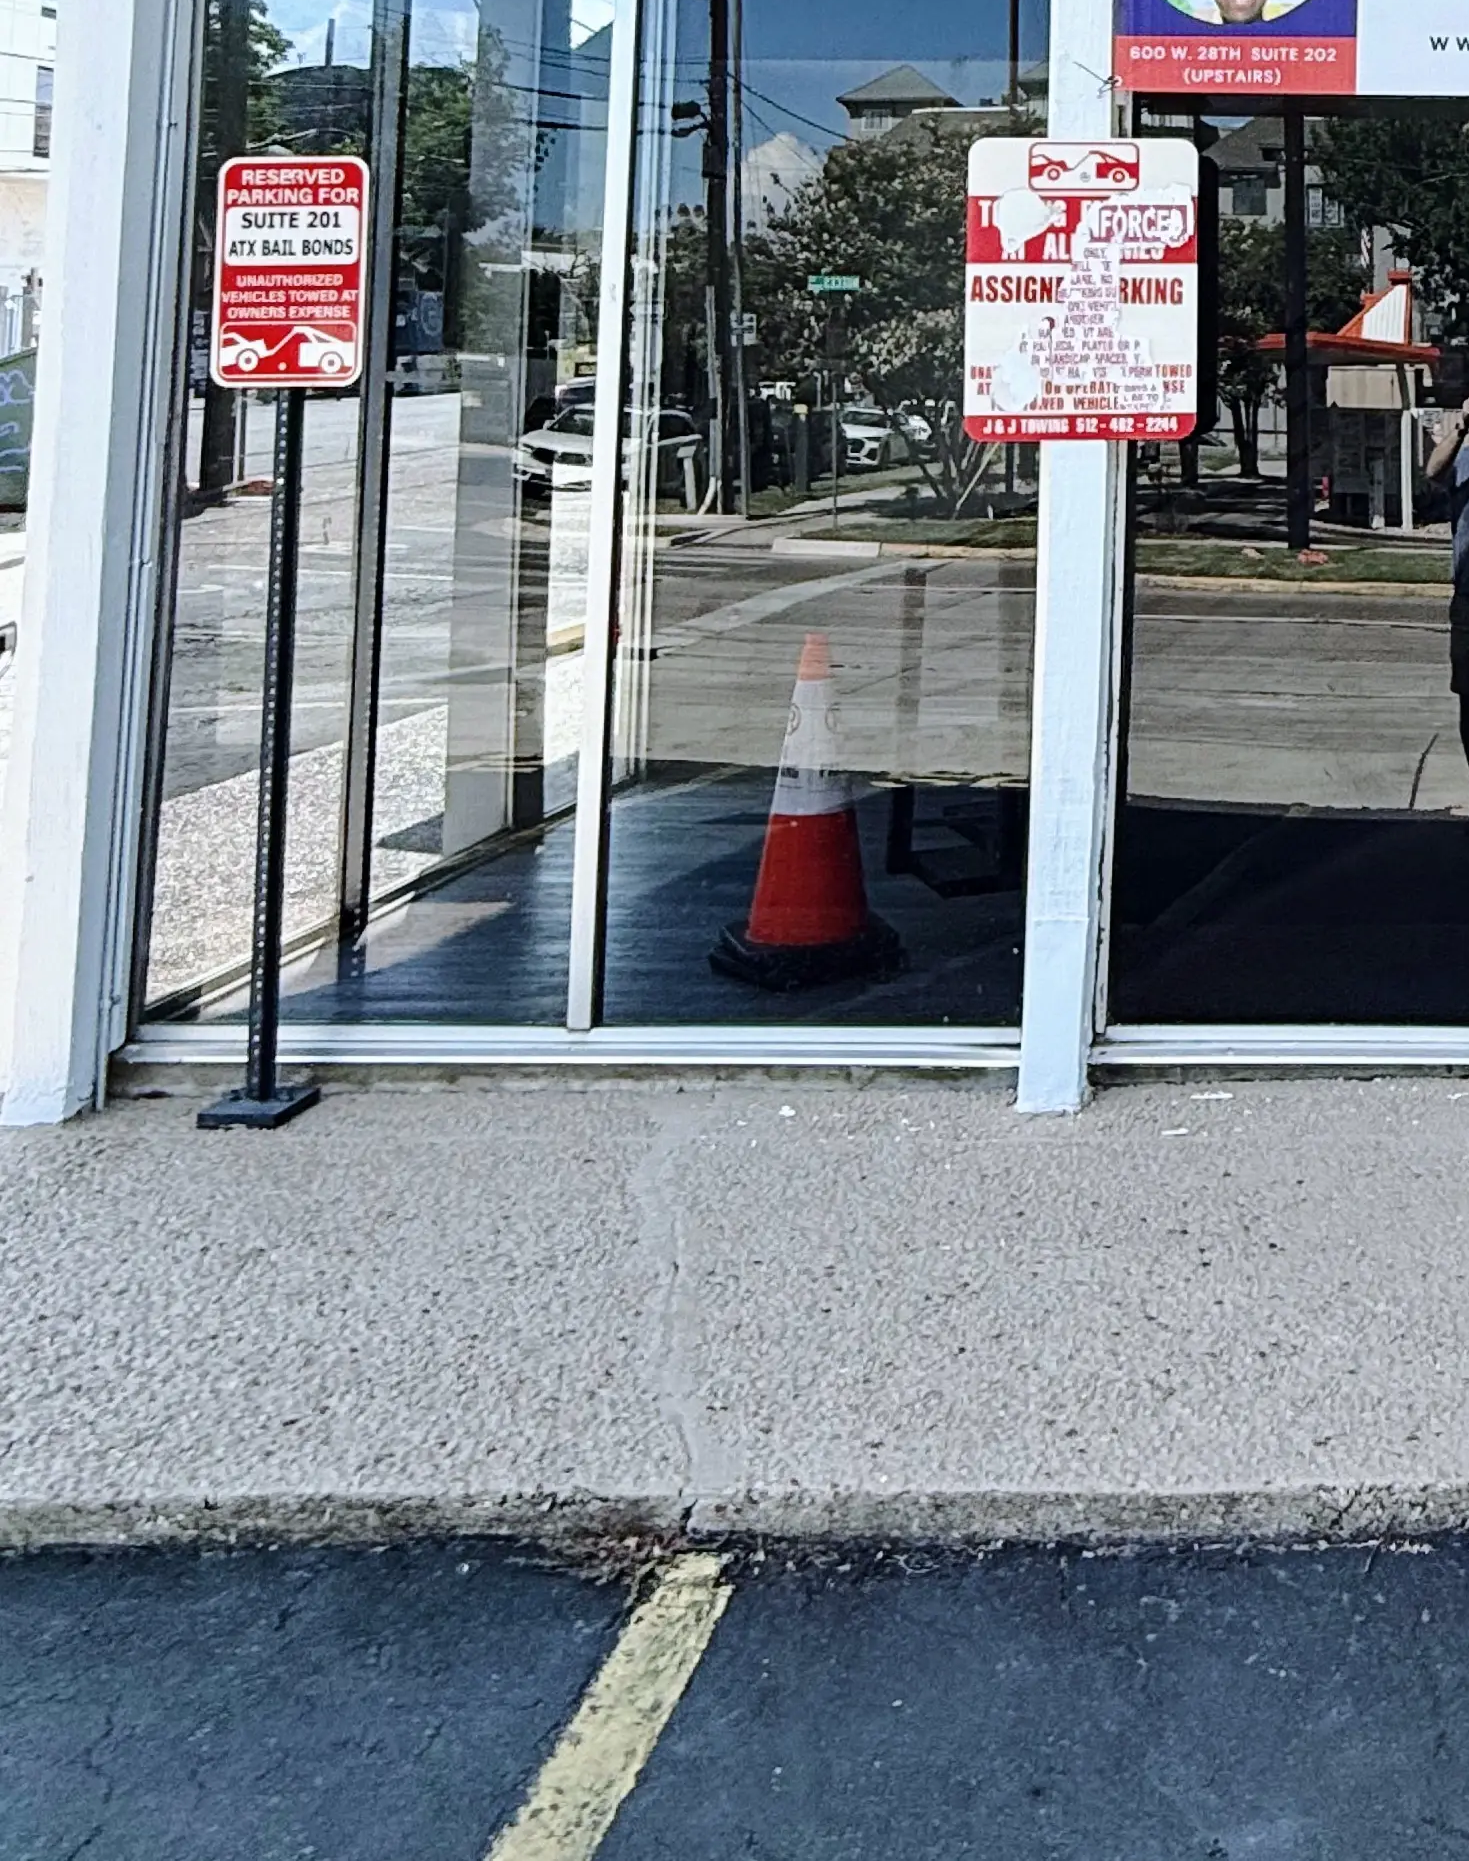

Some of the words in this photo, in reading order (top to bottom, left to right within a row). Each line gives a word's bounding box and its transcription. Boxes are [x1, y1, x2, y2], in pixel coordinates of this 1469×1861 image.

[1129, 46, 1165, 60] 600
[1171, 47, 1192, 60] W.
[1197, 47, 1241, 61] 28TH
[1251, 47, 1299, 61] SUITE
[1304, 48, 1337, 62] 202
[1184, 67, 1282, 85] (UPSTAIRS)
[241, 169, 345, 185] RESERVED
[227, 188, 313, 205] PARKING
[317, 187, 359, 204] FOR
[241, 212, 299, 229] SUITE
[307, 211, 341, 228] 201
[229, 240, 257, 256] ATX
[261, 240, 296, 256] BAIL
[302, 239, 353, 256] BONDS
[236, 274, 344, 287] UNAUTHORIZED
[221, 291, 286, 304] VEHICLES
[289, 290, 339, 303] TOWED
[341, 289, 358, 302] AT
[227, 306, 286, 319] OWNERS
[289, 305, 351, 319] EXPENSE
[983, 419, 992, 434] J
[1007, 419, 1017, 434] J
[1020, 418, 1069, 434] TOWING
